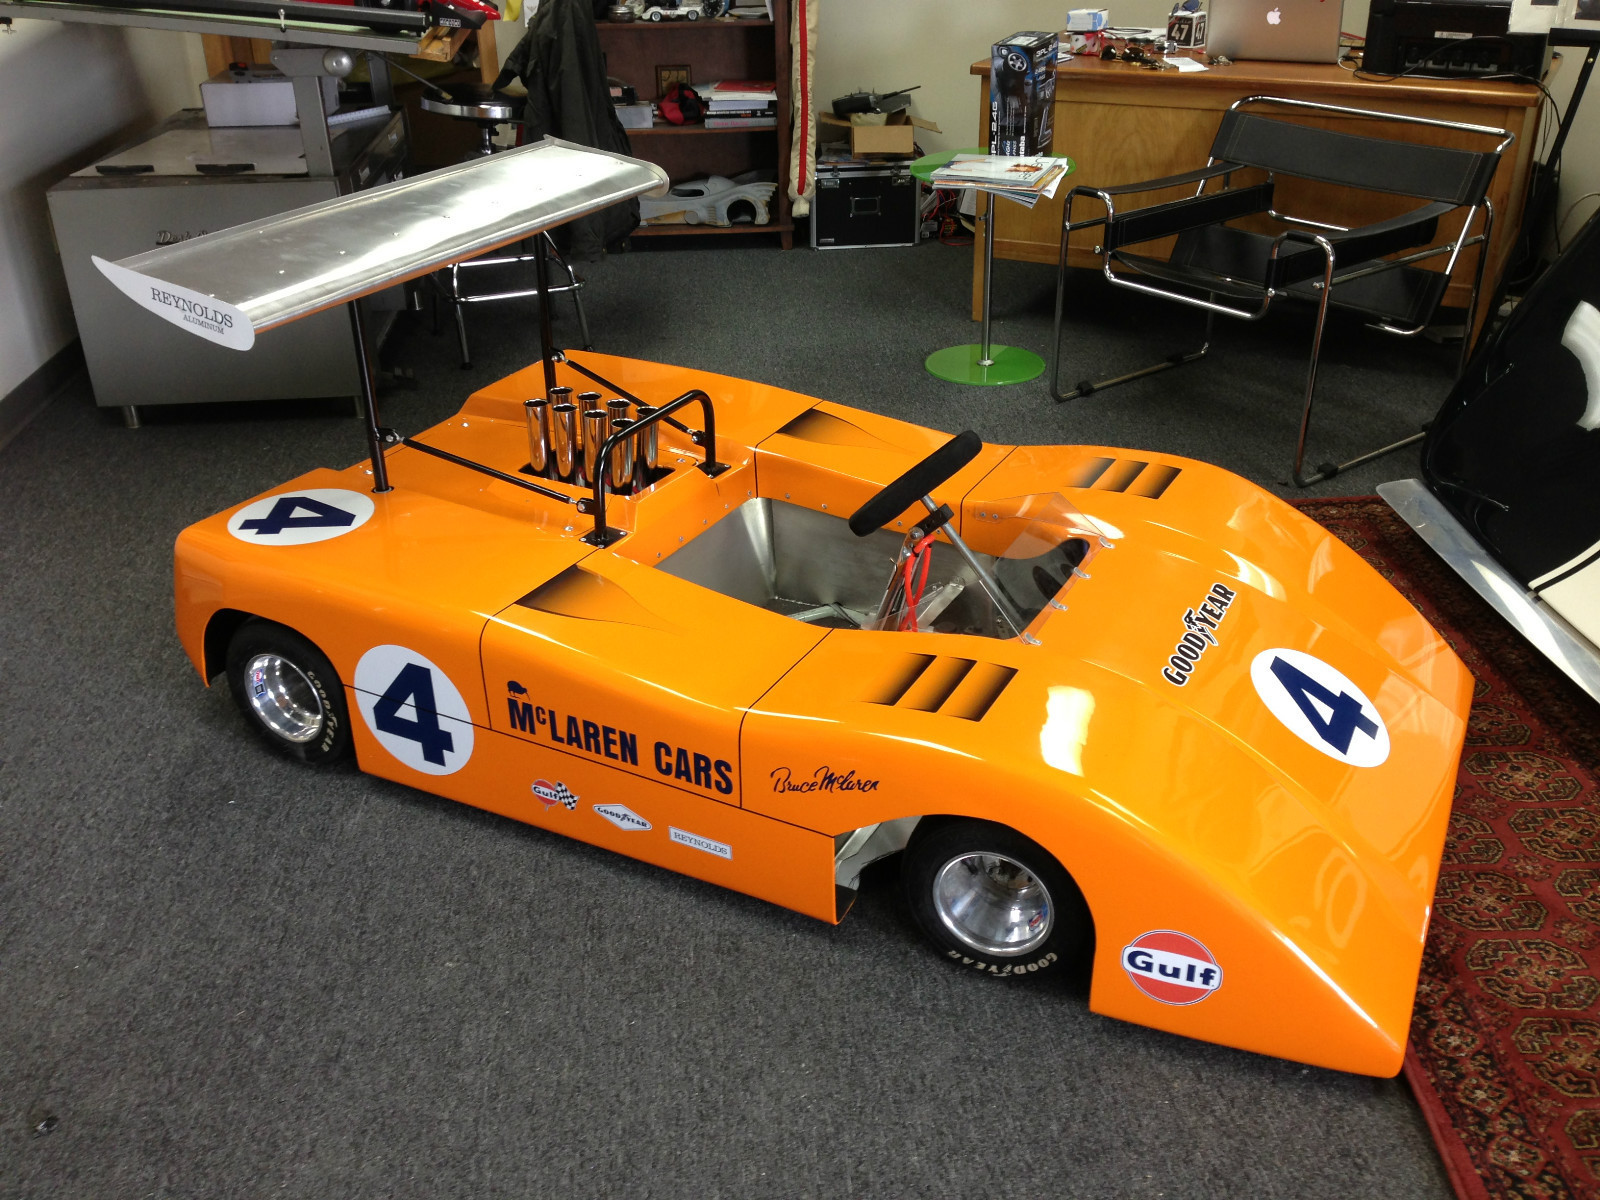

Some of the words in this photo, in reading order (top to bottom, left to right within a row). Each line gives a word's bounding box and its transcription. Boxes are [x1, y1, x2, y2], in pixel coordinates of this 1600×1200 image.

[1171, 23, 1189, 40] 47
[151, 286, 233, 329] REYNOLDS
[183, 313, 225, 335] ALUMINUM
[239, 497, 356, 535] 4
[1162, 582, 1236, 687] GOODYEAR
[373, 662, 454, 767] 4
[1269, 655, 1379, 756] 4
[654, 741, 733, 795] CARS
[770, 766, 818, 793] Bruce
[533, 785, 558, 801] Gulf
[597, 806, 648, 829] GOODYEAR
[674, 831, 728, 856] REYNOLDS
[1127, 950, 1217, 987] Gulf
